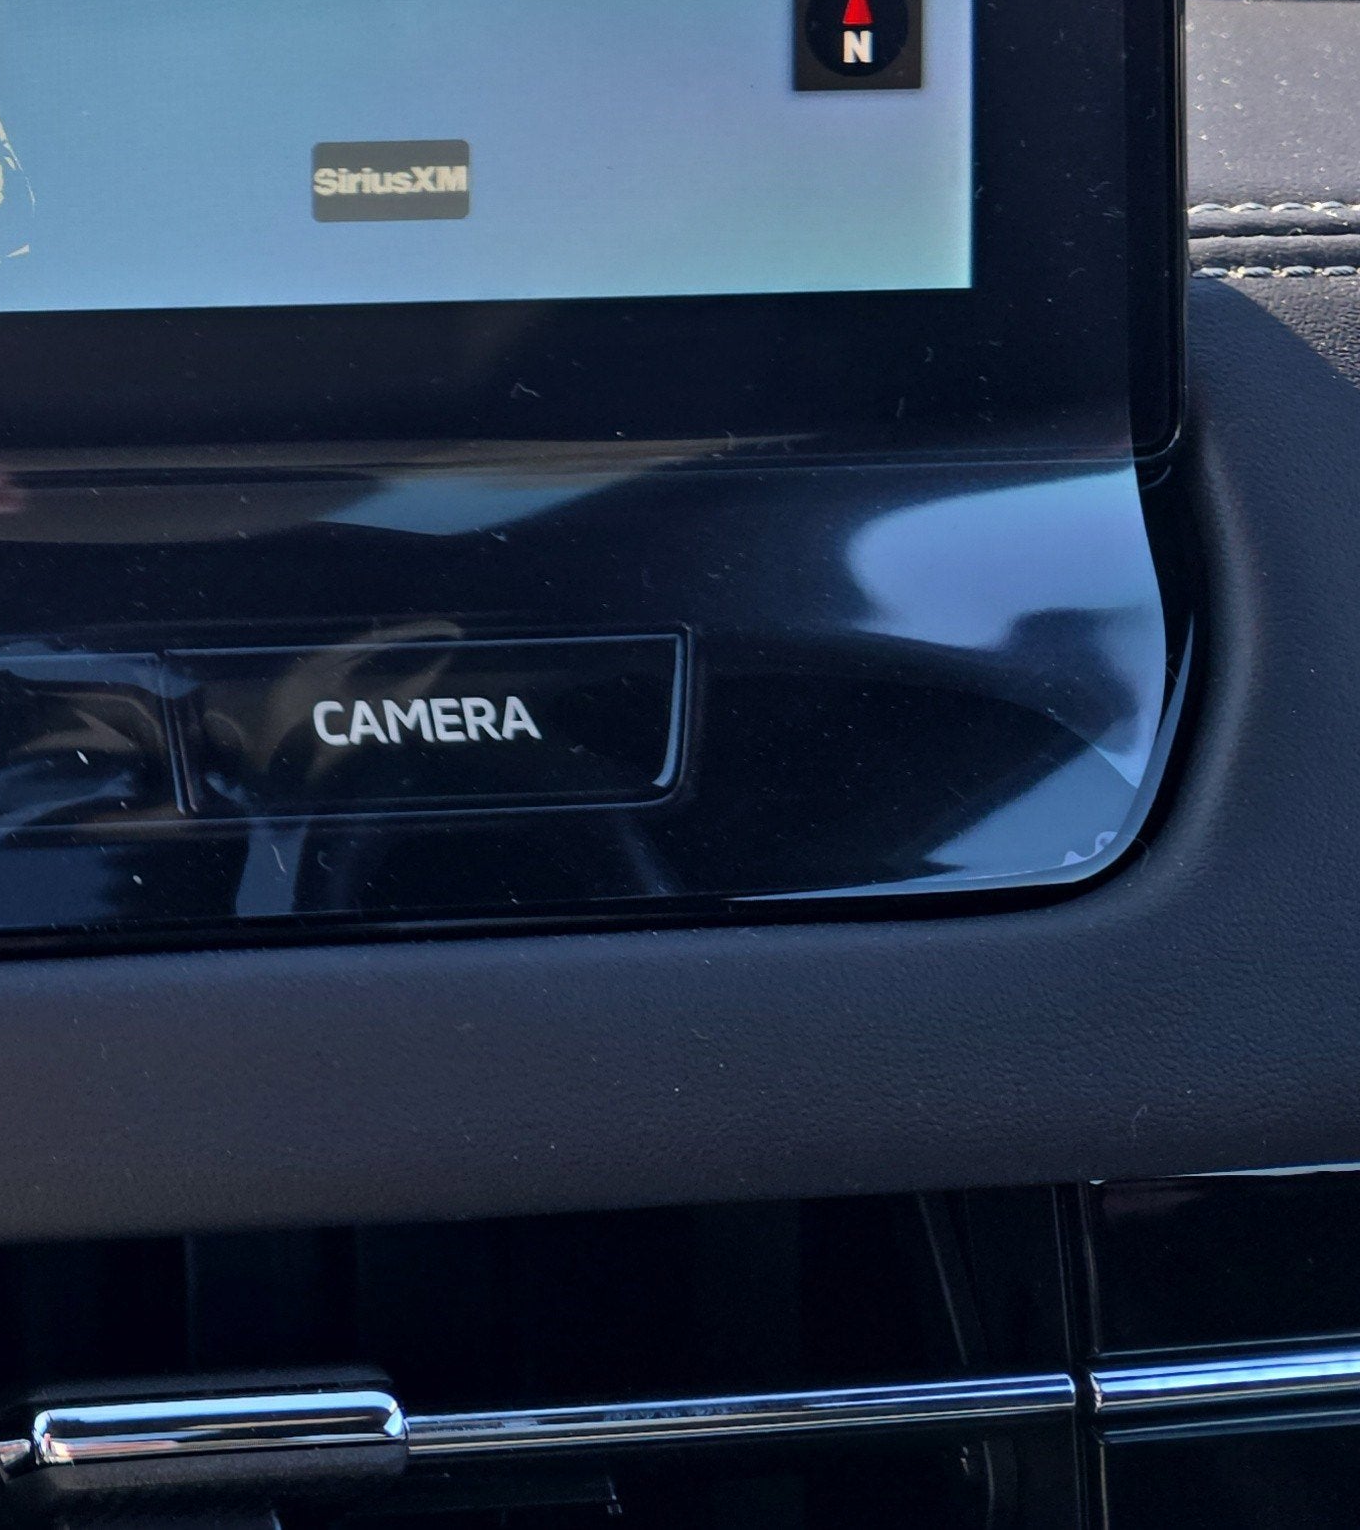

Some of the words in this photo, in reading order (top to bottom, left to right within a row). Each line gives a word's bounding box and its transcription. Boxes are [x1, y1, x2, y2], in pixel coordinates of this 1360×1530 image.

[842, 30, 873, 64] N
[313, 165, 468, 195] SiriusXM
[313, 695, 541, 746] CAMERA
